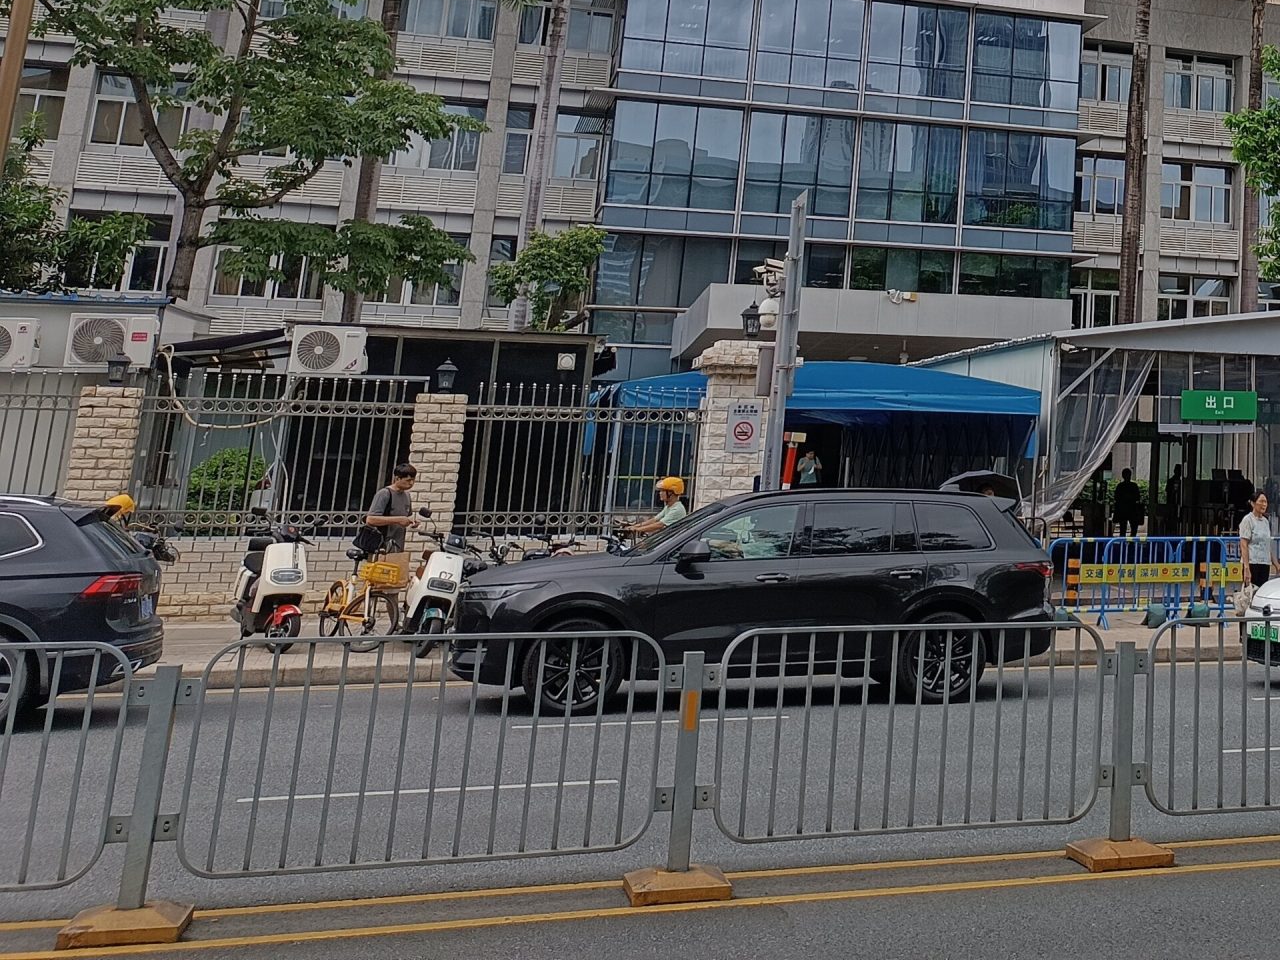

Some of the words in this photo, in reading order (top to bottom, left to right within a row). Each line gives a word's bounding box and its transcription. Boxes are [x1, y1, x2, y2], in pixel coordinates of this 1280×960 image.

[1205, 395, 1234, 409] 出口
[1085, 568, 1103, 578] 交通
[1140, 568, 1159, 577] 深圳
[1172, 567, 1190, 577] 交警
